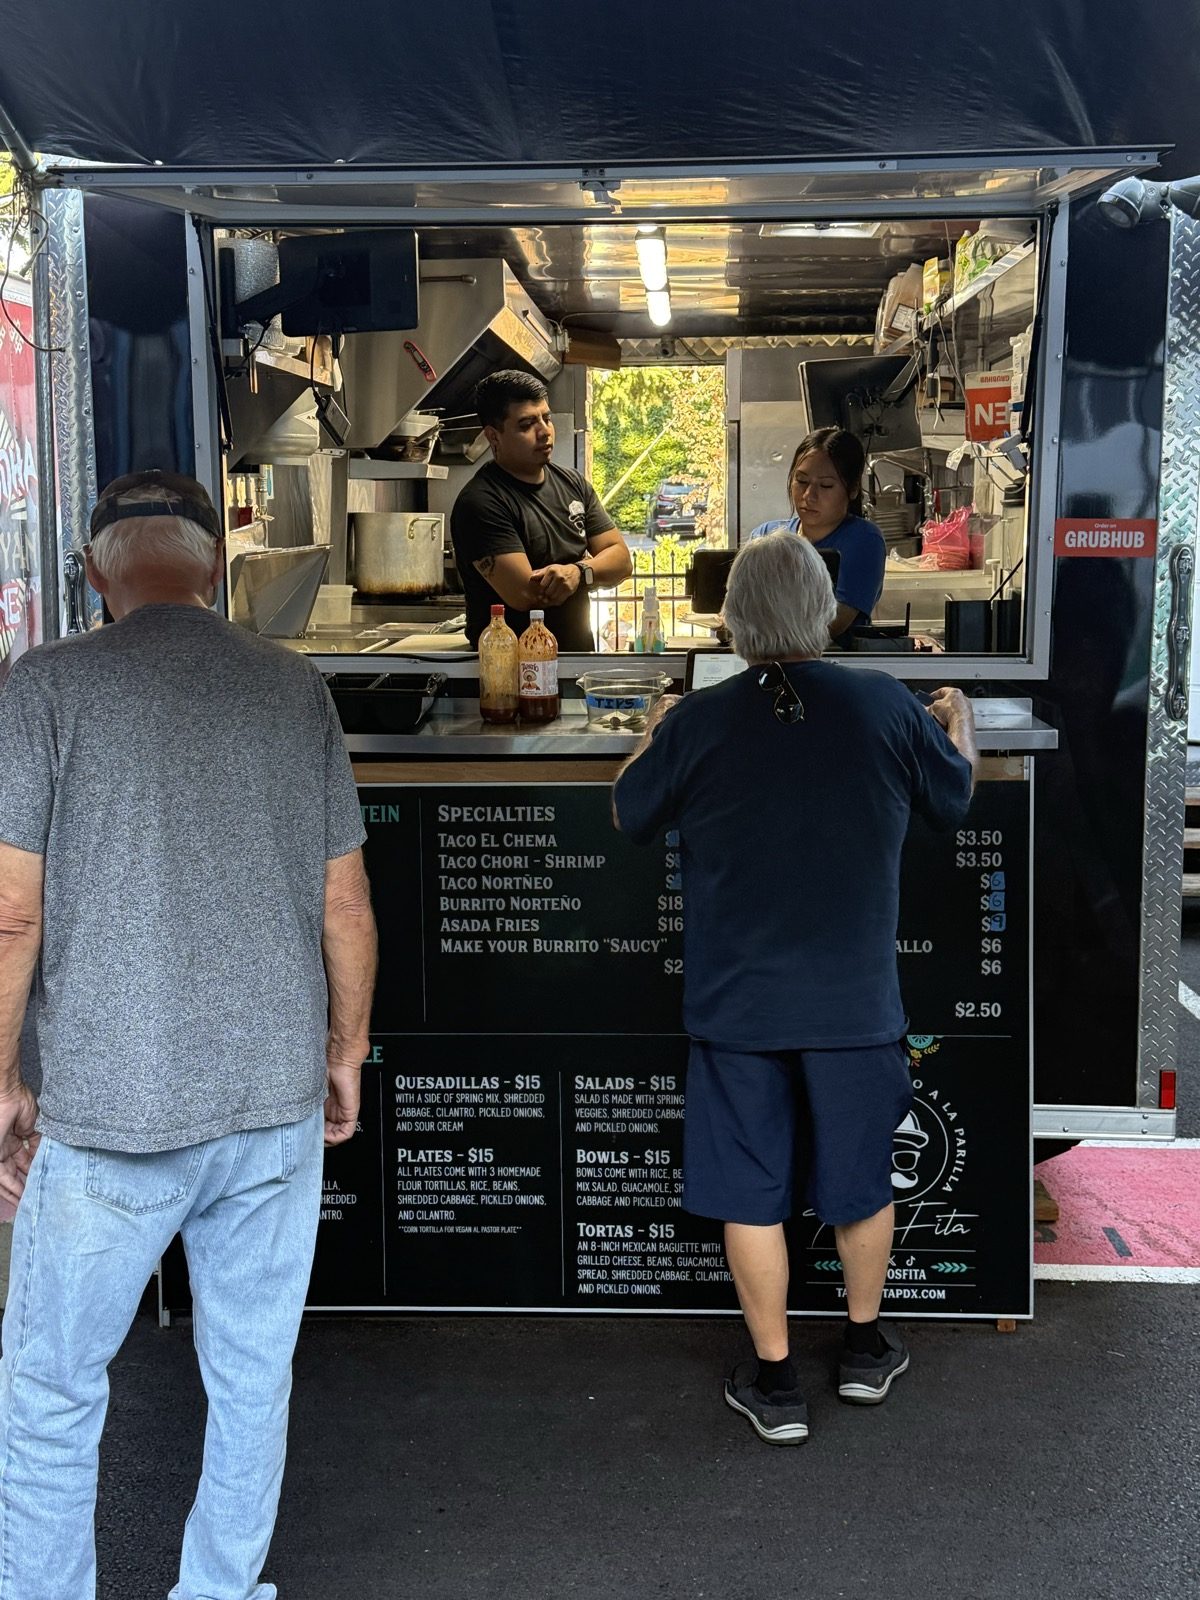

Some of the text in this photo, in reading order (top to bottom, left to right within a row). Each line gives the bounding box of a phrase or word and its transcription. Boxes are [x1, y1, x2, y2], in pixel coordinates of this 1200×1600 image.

[974, 402, 1009, 426] EN
[1064, 530, 1145, 548] GRUBHUB
[595, 698, 635, 709] TIPS
[362, 805, 399, 822] TEIN
[438, 805, 555, 822] SPECIALTIES
[438, 833, 557, 847] TACO EL CHEMA
[956, 830, 1002, 846] $3.50
[438, 854, 476, 868] TACO
[481, 854, 528, 868] CHORI
[545, 854, 605, 868] SHRIMP
[956, 851, 1002, 868] $3.50
[439, 876, 477, 890] TACO
[440, 895, 581, 911] BURRITO NORTEÑO
[658, 895, 683, 911] $18
[440, 918, 539, 932] ASADA FRIES
[658, 916, 683, 932] $16
[441, 939, 483, 952] MAKE
[487, 940, 528, 952] YOUR
[533, 938, 599, 952] BURRITO
[895, 940, 932, 952] ALLO
[981, 937, 1001, 954] $6
[981, 959, 1001, 975] $6
[956, 1001, 1001, 1018] $2.50
[395, 1075, 499, 1090] QUESADILLAS
[515, 1074, 540, 1090] $15
[575, 1075, 634, 1090] SALADS
[650, 1075, 676, 1091] $15
[396, 1093, 414, 1103] WITH
[417, 1093, 422, 1103] A
[424, 1093, 441, 1103] SIDE
[444, 1093, 454, 1103] OF
[456, 1093, 483, 1103] SPRING
[504, 1093, 544, 1103] SHREDDED
[575, 1094, 685, 1104] SALAD IS MADE WITH SPRING
[479, 1107, 511, 1117] PICKLED
[612, 1108, 653, 1118] SHREDDED
[655, 1109, 685, 1119] CABBAG
[396, 1121, 463, 1131] AND SOUR CREAM
[576, 1122, 591, 1132] AND
[594, 1122, 626, 1132] PICKLED
[929, 1090, 966, 1193] A LA PARILLA
[398, 1148, 452, 1162] PLATES
[468, 1147, 493, 1163] $15
[577, 1149, 629, 1164] BOWLS
[645, 1150, 670, 1165] $15
[397, 1167, 541, 1176] ALL PLATES COME WITH 3 HOMEMADE
[576, 1168, 602, 1177] BOWLS
[604, 1168, 626, 1178] COME
[629, 1168, 647, 1178] WITH
[398, 1181, 422, 1190] FLOUR
[577, 1182, 590, 1191] MIX
[321, 1195, 356, 1204] HREDDED
[398, 1195, 438, 1204] SHREDDED
[481, 1195, 513, 1205] PICKLED
[577, 1196, 612, 1206] CABBAGE
[614, 1197, 630, 1206] AND
[633, 1197, 665, 1207] PICKLED
[398, 1210, 414, 1220] AND
[577, 1223, 633, 1237] TORTAS
[649, 1223, 674, 1239] $15
[577, 1241, 720, 1253] AN 8-INCH MEXICAN BAGUETTE WITH
[577, 1255, 610, 1265] GRILLED
[677, 1257, 724, 1267] GUACAMOLE
[612, 1270, 652, 1280] SHREDDED
[887, 1269, 926, 1280] OSFITA
[578, 1284, 594, 1293] AND
[597, 1284, 629, 1294] PICKLED
